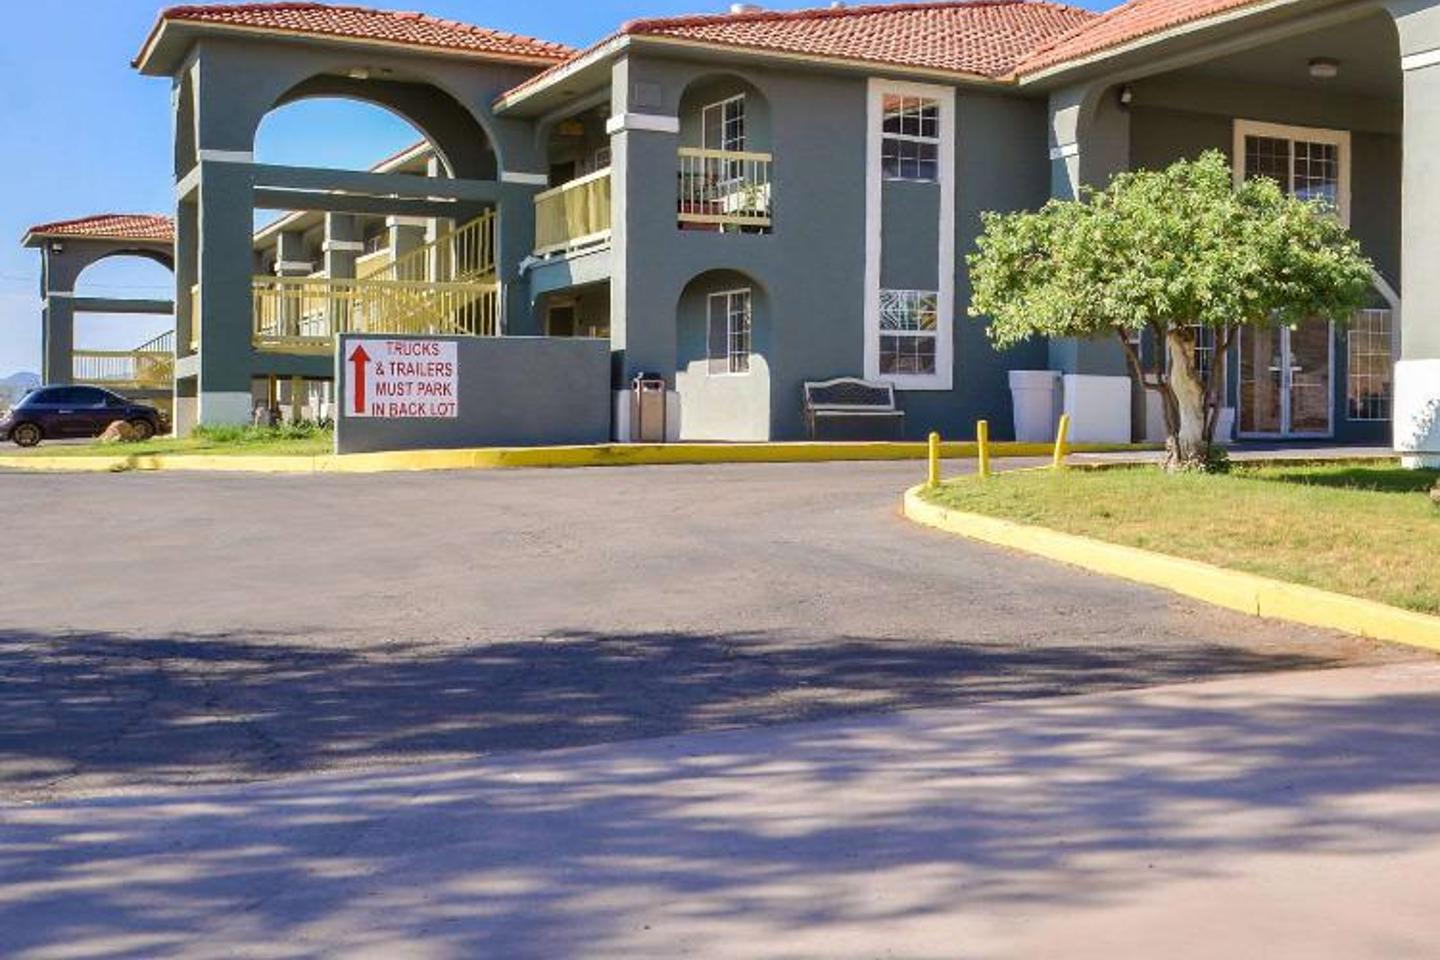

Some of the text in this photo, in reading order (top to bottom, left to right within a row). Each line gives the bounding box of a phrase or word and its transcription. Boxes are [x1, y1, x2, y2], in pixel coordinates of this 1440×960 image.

[386, 341, 439, 356] TRUCKS
[375, 362, 453, 376] & TRAILERS
[376, 382, 452, 396] MUST PARK
[372, 402, 456, 417] IN BACK LOT
